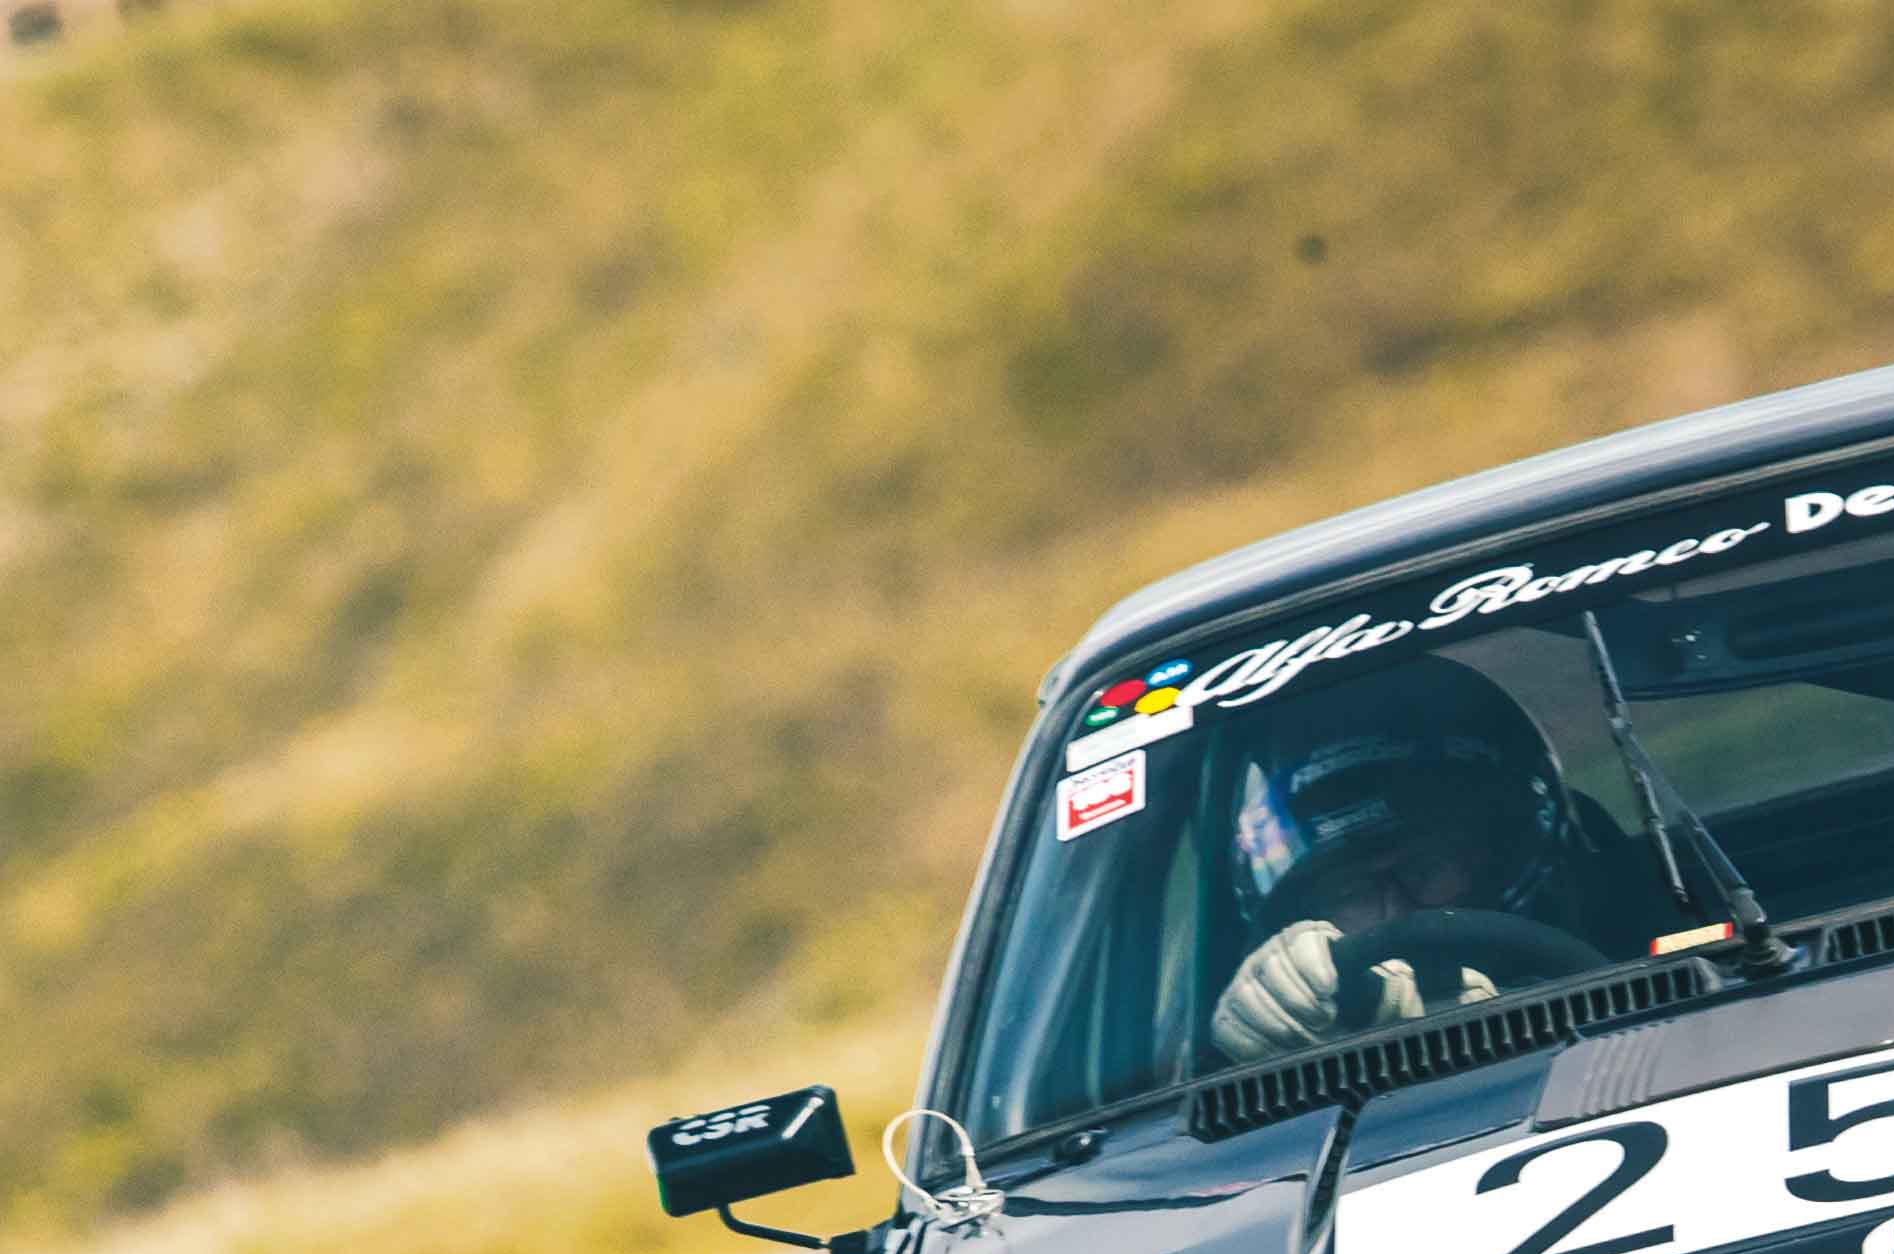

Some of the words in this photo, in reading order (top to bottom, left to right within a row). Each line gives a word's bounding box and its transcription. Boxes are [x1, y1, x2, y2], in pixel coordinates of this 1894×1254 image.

[1176, 614, 1415, 707] Alfa
[1418, 522, 1770, 630] Romeo
[672, 1104, 771, 1146] CSR
